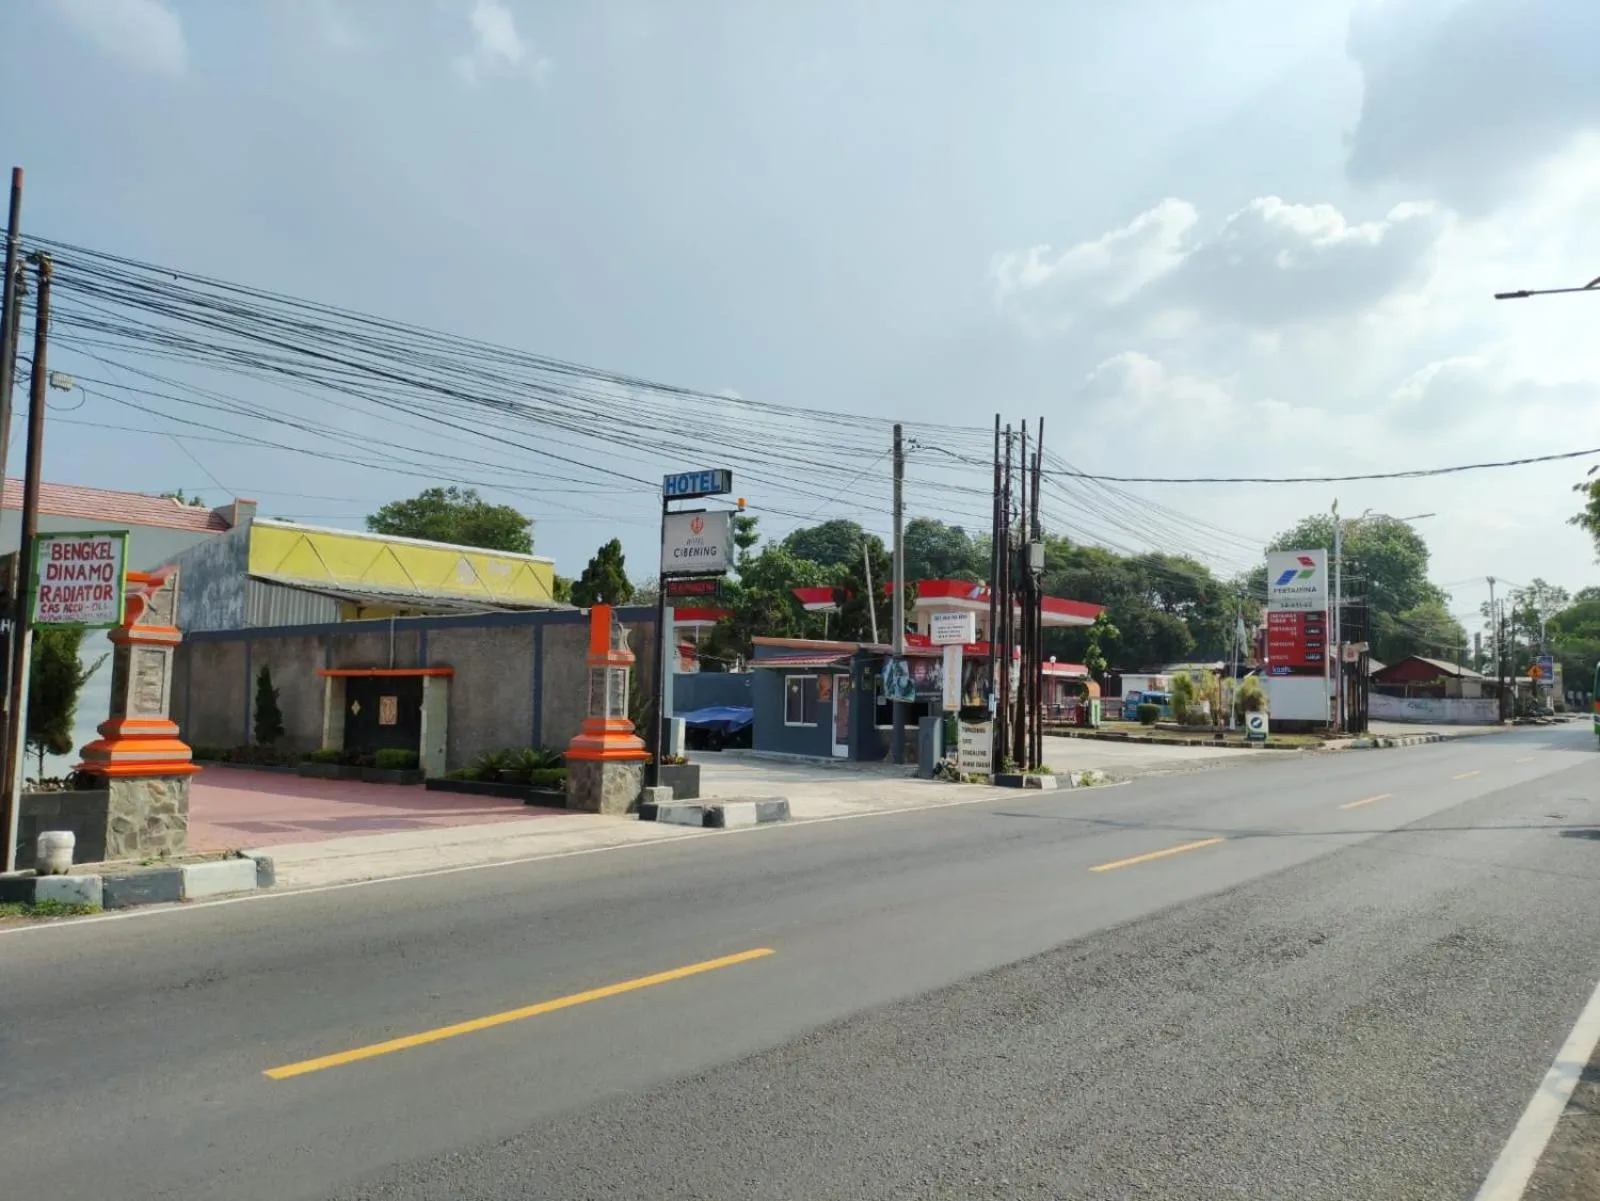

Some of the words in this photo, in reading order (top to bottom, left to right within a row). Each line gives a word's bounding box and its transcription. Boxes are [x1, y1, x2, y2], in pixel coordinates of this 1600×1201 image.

[666, 472, 720, 494] HOTEL
[51, 541, 115, 561] BENGKEL
[46, 562, 114, 582] DINAMO
[39, 584, 113, 602] RADIATOR
[40, 603, 60, 613] CAS
